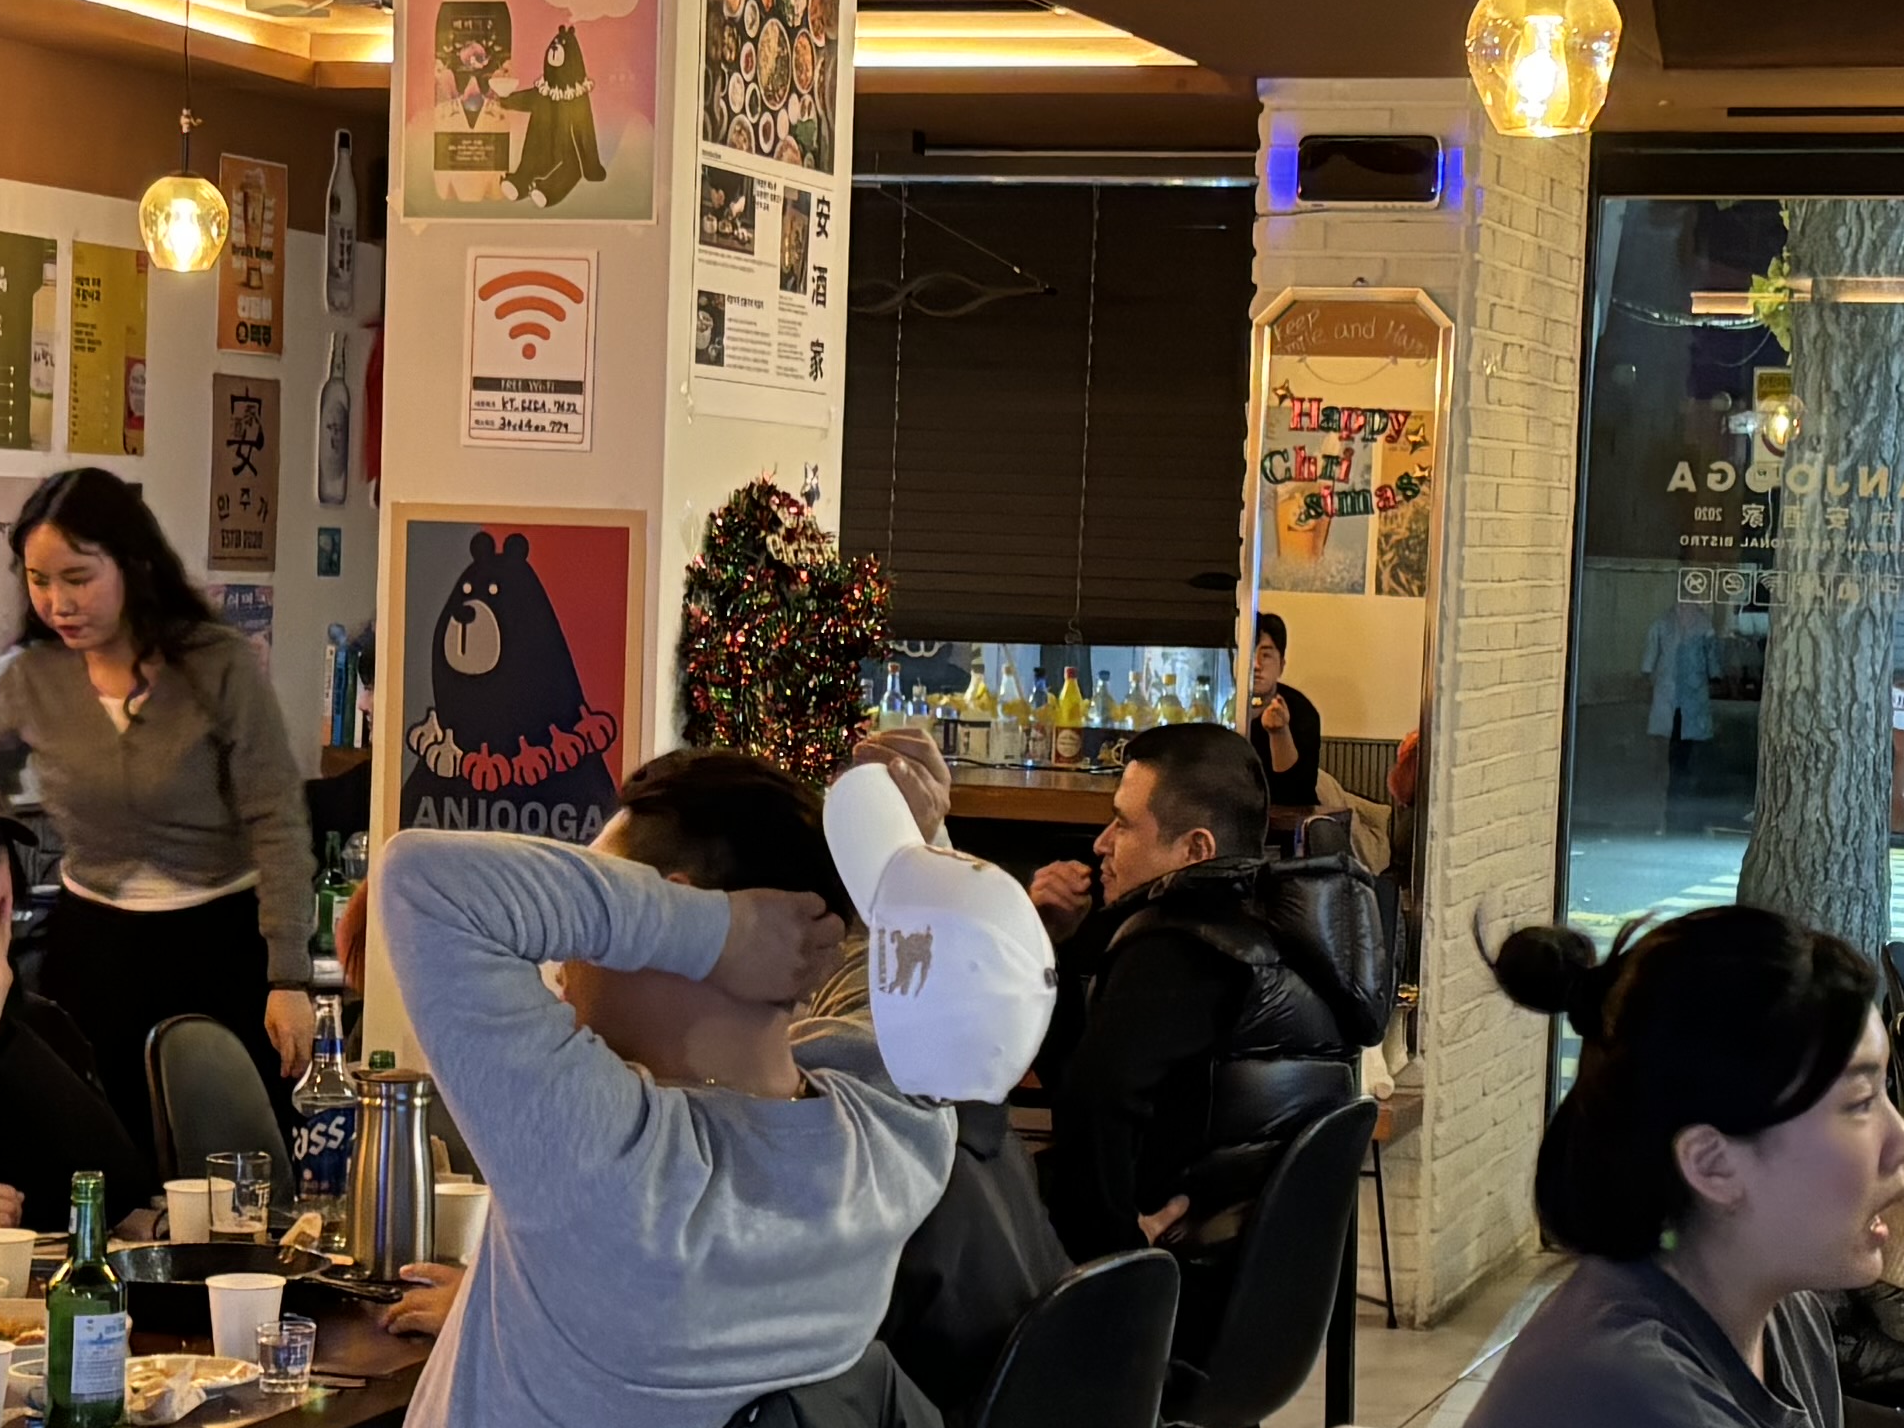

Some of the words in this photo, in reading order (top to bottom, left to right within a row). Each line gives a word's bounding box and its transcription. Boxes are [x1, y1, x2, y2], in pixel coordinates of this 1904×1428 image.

[808, 194, 832, 383] 安酒家
[1333, 315, 1376, 340] and
[1289, 397, 1413, 444] Happy
[1261, 445, 1355, 485] Chri
[410, 795, 606, 842] ANJOOGA
